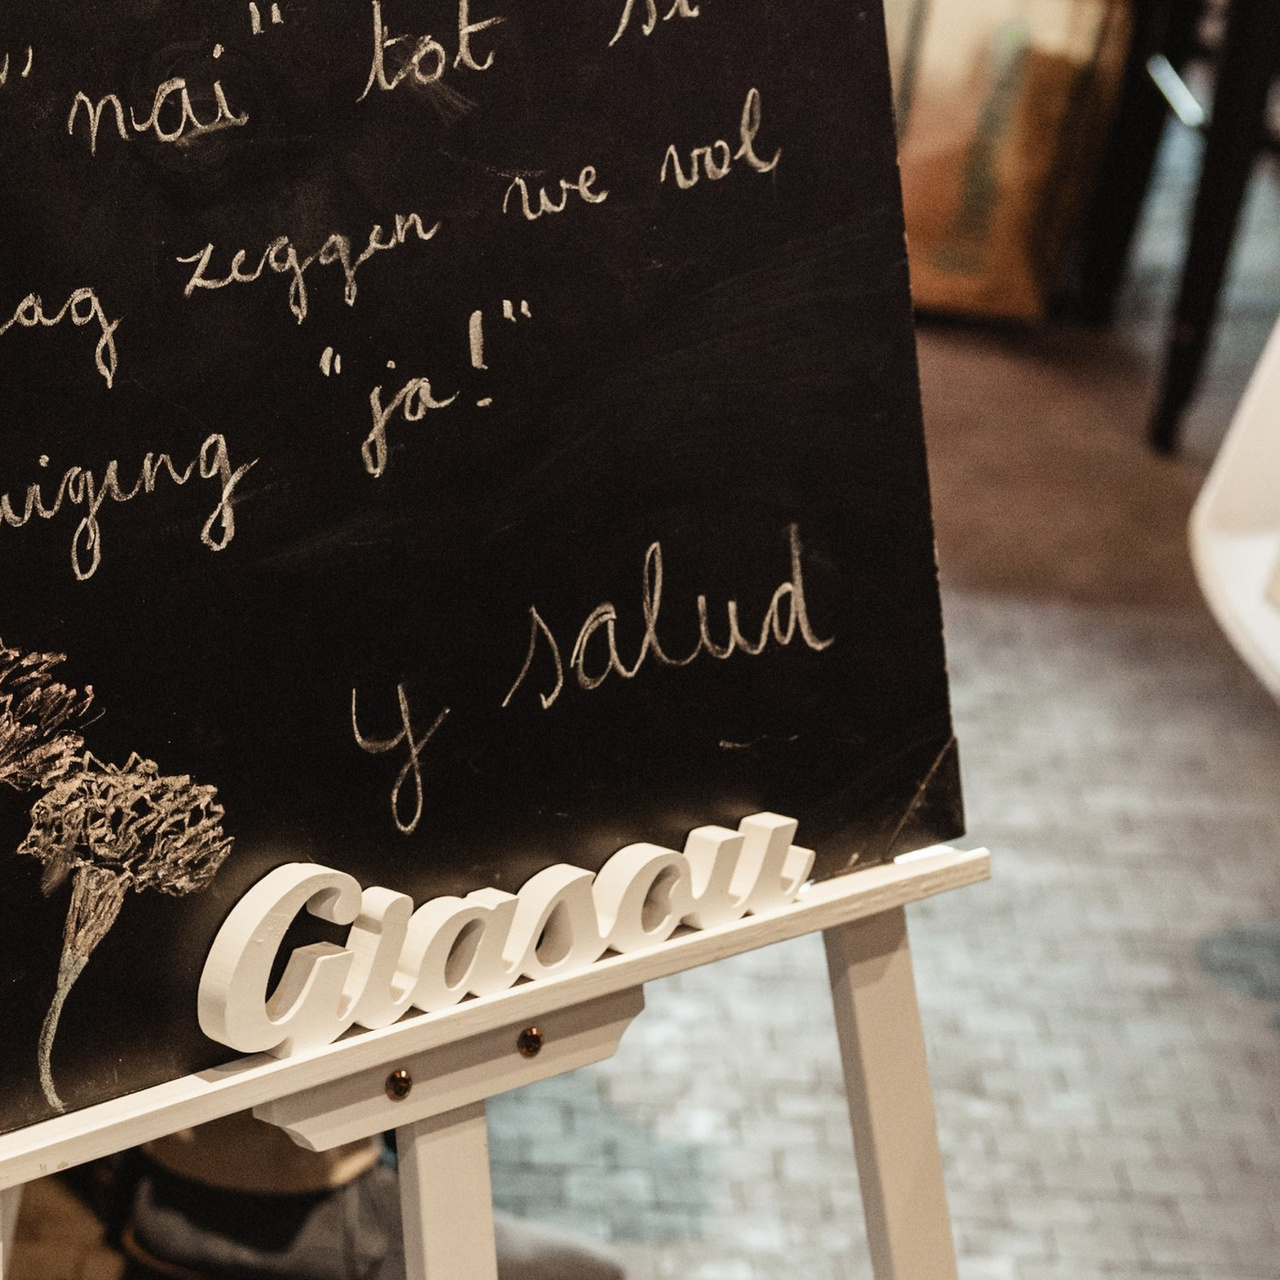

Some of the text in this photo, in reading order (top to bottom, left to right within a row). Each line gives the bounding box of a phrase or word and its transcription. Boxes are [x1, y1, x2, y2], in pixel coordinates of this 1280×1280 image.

[175, 211, 440, 326] zeggen
[502, 163, 610, 222] we
[660, 87, 781, 192] vol
[351, 523, 836, 835] y salud
[196, 811, 817, 1058] Giasou
